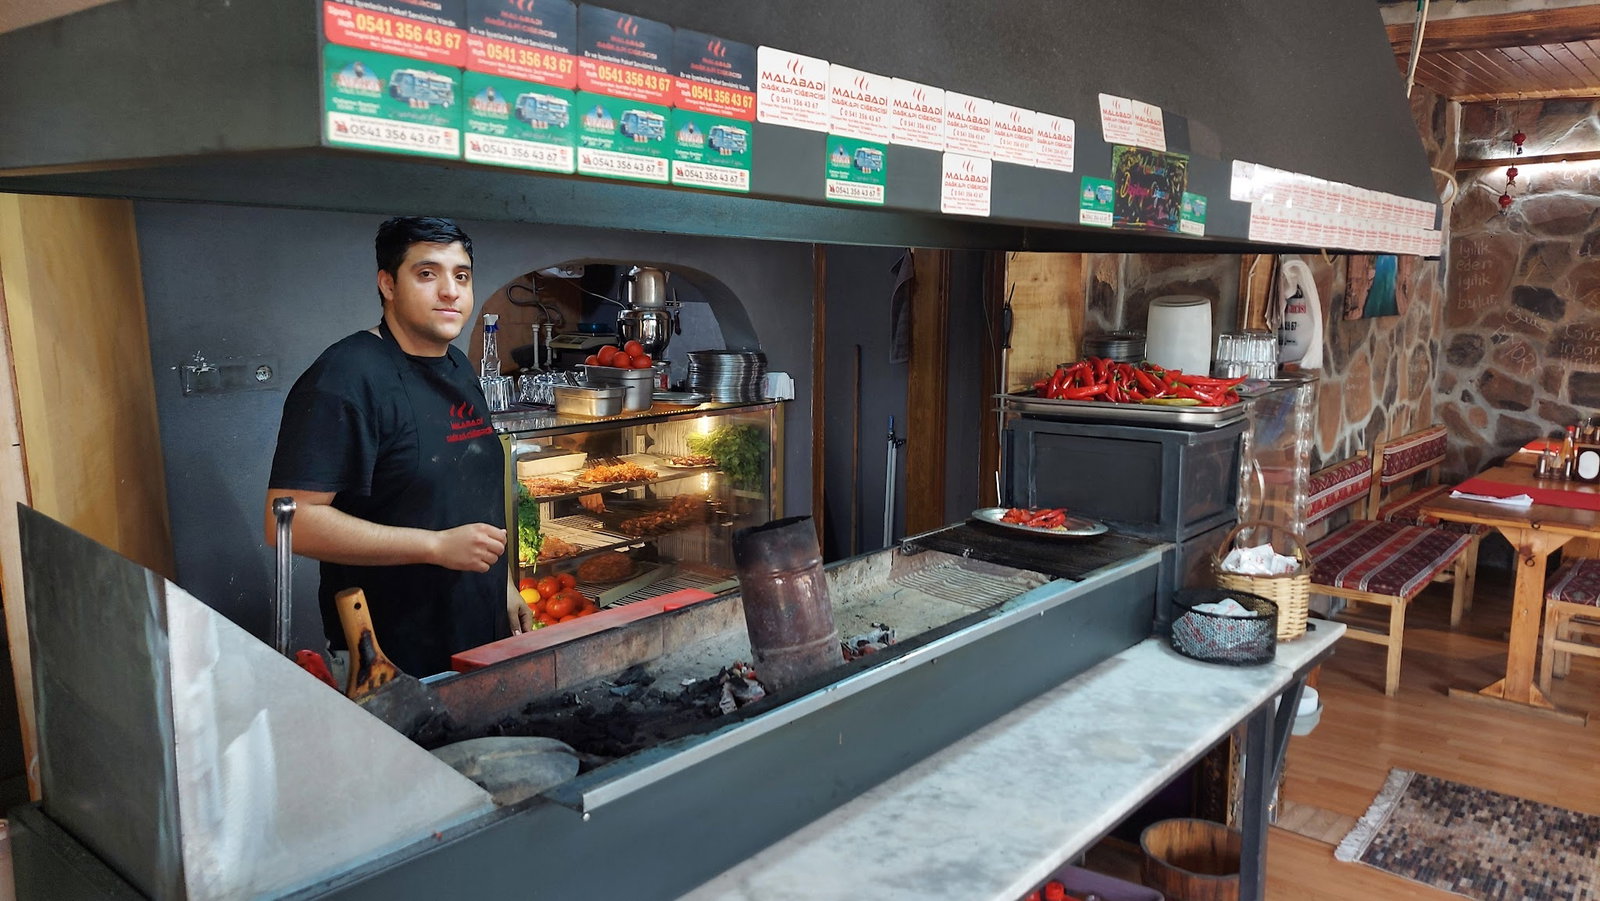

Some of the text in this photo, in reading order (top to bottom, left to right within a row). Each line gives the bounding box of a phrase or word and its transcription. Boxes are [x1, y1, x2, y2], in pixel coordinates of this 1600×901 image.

[356, 12, 392, 36] 0541
[395, 21, 422, 42] 356
[424, 27, 441, 46] 43
[444, 31, 461, 50] 67
[486, 42, 516, 63] 0541
[519, 49, 540, 68] 356
[542, 54, 556, 71] 43
[559, 57, 572, 73] 67
[598, 65, 623, 83] 0541
[625, 70, 643, 87] 356
[645, 74, 656, 89] 43
[658, 77, 670, 92] 67
[762, 70, 825, 91] MALABADİ
[691, 84, 712, 101] 0541
[714, 88, 730, 104] 356
[731, 92, 741, 106] 43
[742, 94, 752, 108] 67
[781, 96, 790, 104] 541
[793, 98, 802, 106] 356
[832, 86, 887, 105] MALABADİ
[893, 98, 942, 115] MALABADİ
[350, 124, 381, 137] 0541
[385, 129, 406, 140] 356
[410, 133, 424, 142] 43
[428, 134, 439, 144] 67
[482, 143, 507, 155] 0541
[512, 147, 529, 158] 356
[532, 150, 543, 160] 43
[546, 152, 556, 161] 67
[593, 157, 613, 167] 0541
[617, 160, 631, 169] 356
[634, 162, 643, 171] 43
[646, 164, 654, 172] 67
[685, 168, 702, 178] 0541
[705, 172, 717, 180] 356
[720, 173, 727, 181] 43
